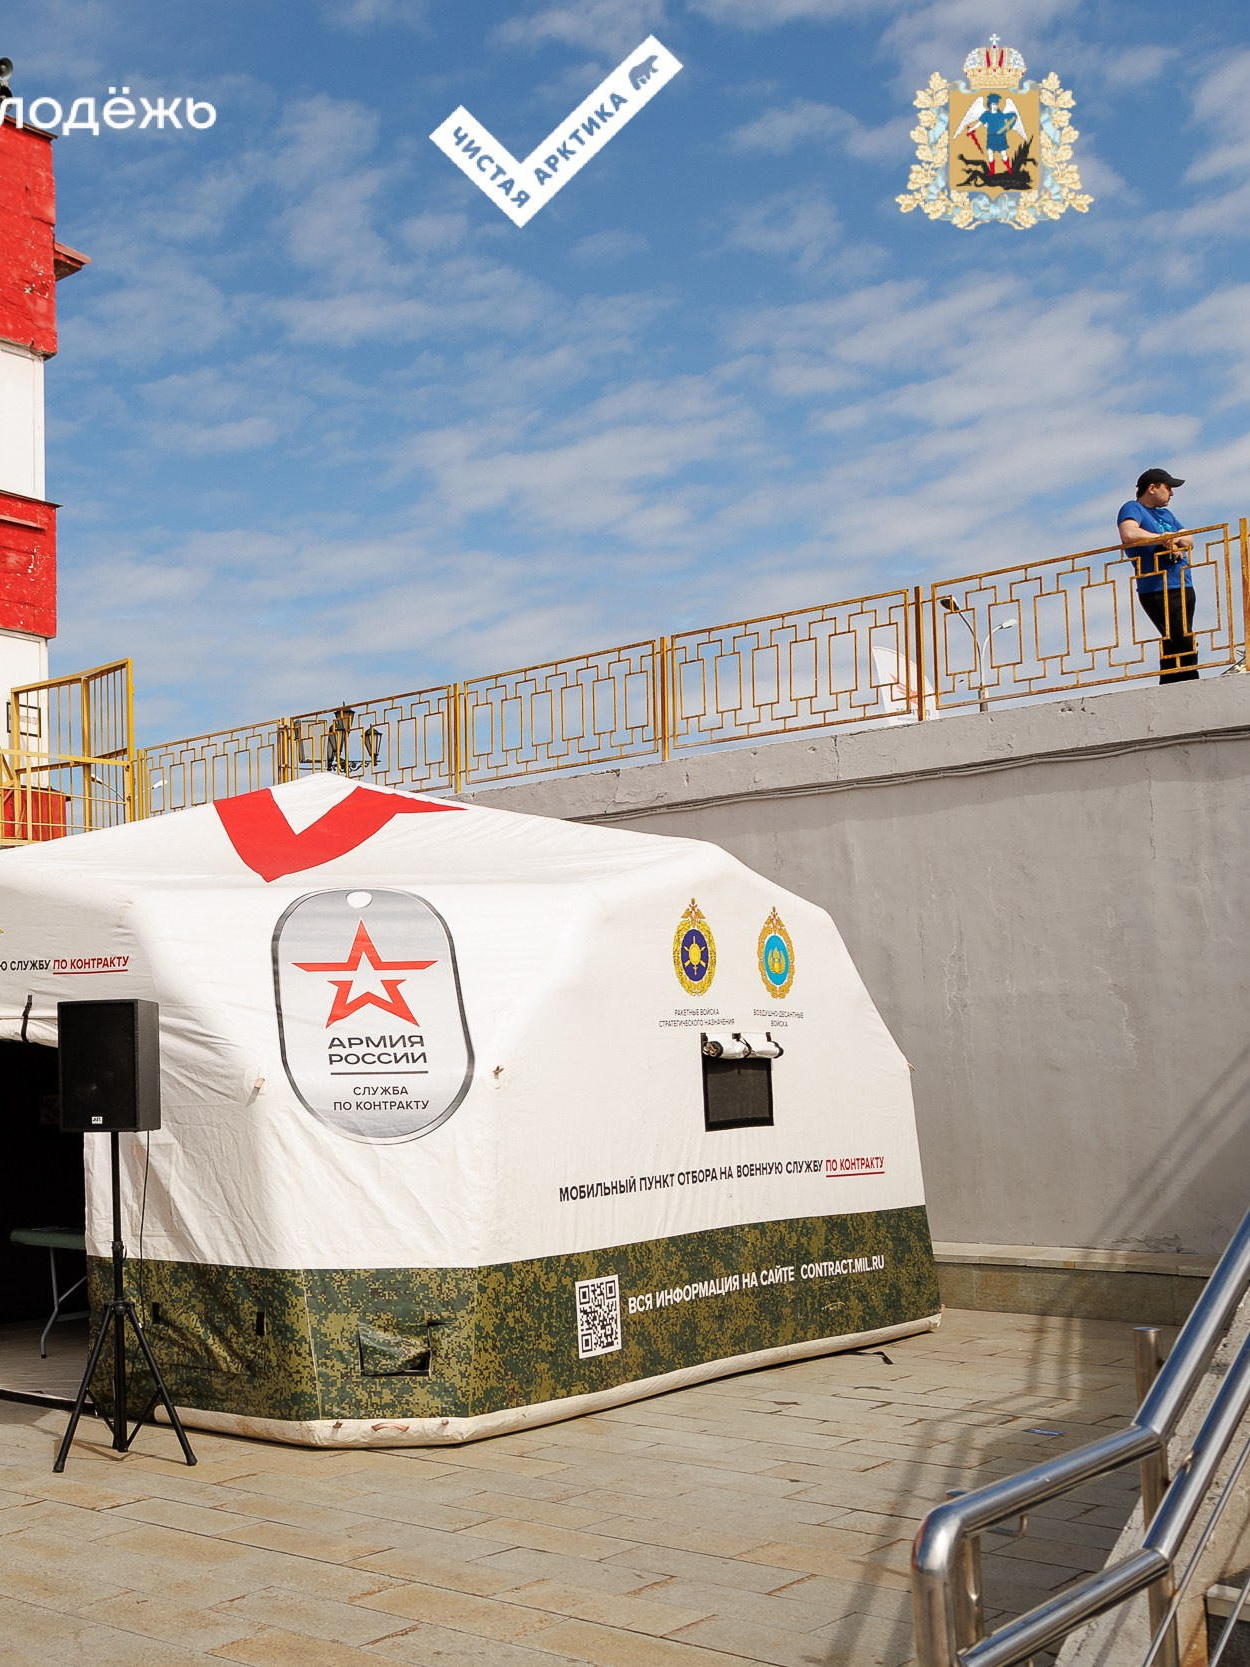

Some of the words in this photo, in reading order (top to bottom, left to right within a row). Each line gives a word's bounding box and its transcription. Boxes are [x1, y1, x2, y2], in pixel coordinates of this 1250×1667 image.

[10, 959, 51, 972] СЛУЖБУ
[53, 958, 68, 971] ПО
[70, 955, 129, 971] КОНТРАКТУ
[328, 1035, 425, 1049] АРМИЯ
[328, 1052, 428, 1066] РОССИИ
[353, 1086, 409, 1097] СЛУЖБА
[333, 1101, 352, 1111] ПО
[356, 1099, 430, 1111] КОНТРАКТУ
[559, 1175, 637, 1203] МОБИЛЬНЫЙ
[639, 1172, 675, 1192] ПУНКТ
[677, 1167, 719, 1186] ОТБОРА
[720, 1167, 734, 1180] НА
[736, 1161, 783, 1179] ВОЕННУЮ
[785, 1159, 823, 1175] СЛУЖБУ
[825, 1158, 837, 1172] ПО
[839, 1156, 885, 1171] КОНТРАКТУ
[628, 1293, 653, 1315] ВСЯ
[655, 1275, 740, 1307] ИНФОРМАЦИЯ
[742, 1274, 758, 1289] НА
[760, 1263, 795, 1285] САЙТЕ
[800, 1254, 885, 1280] CONTRACT.MIL.RU
